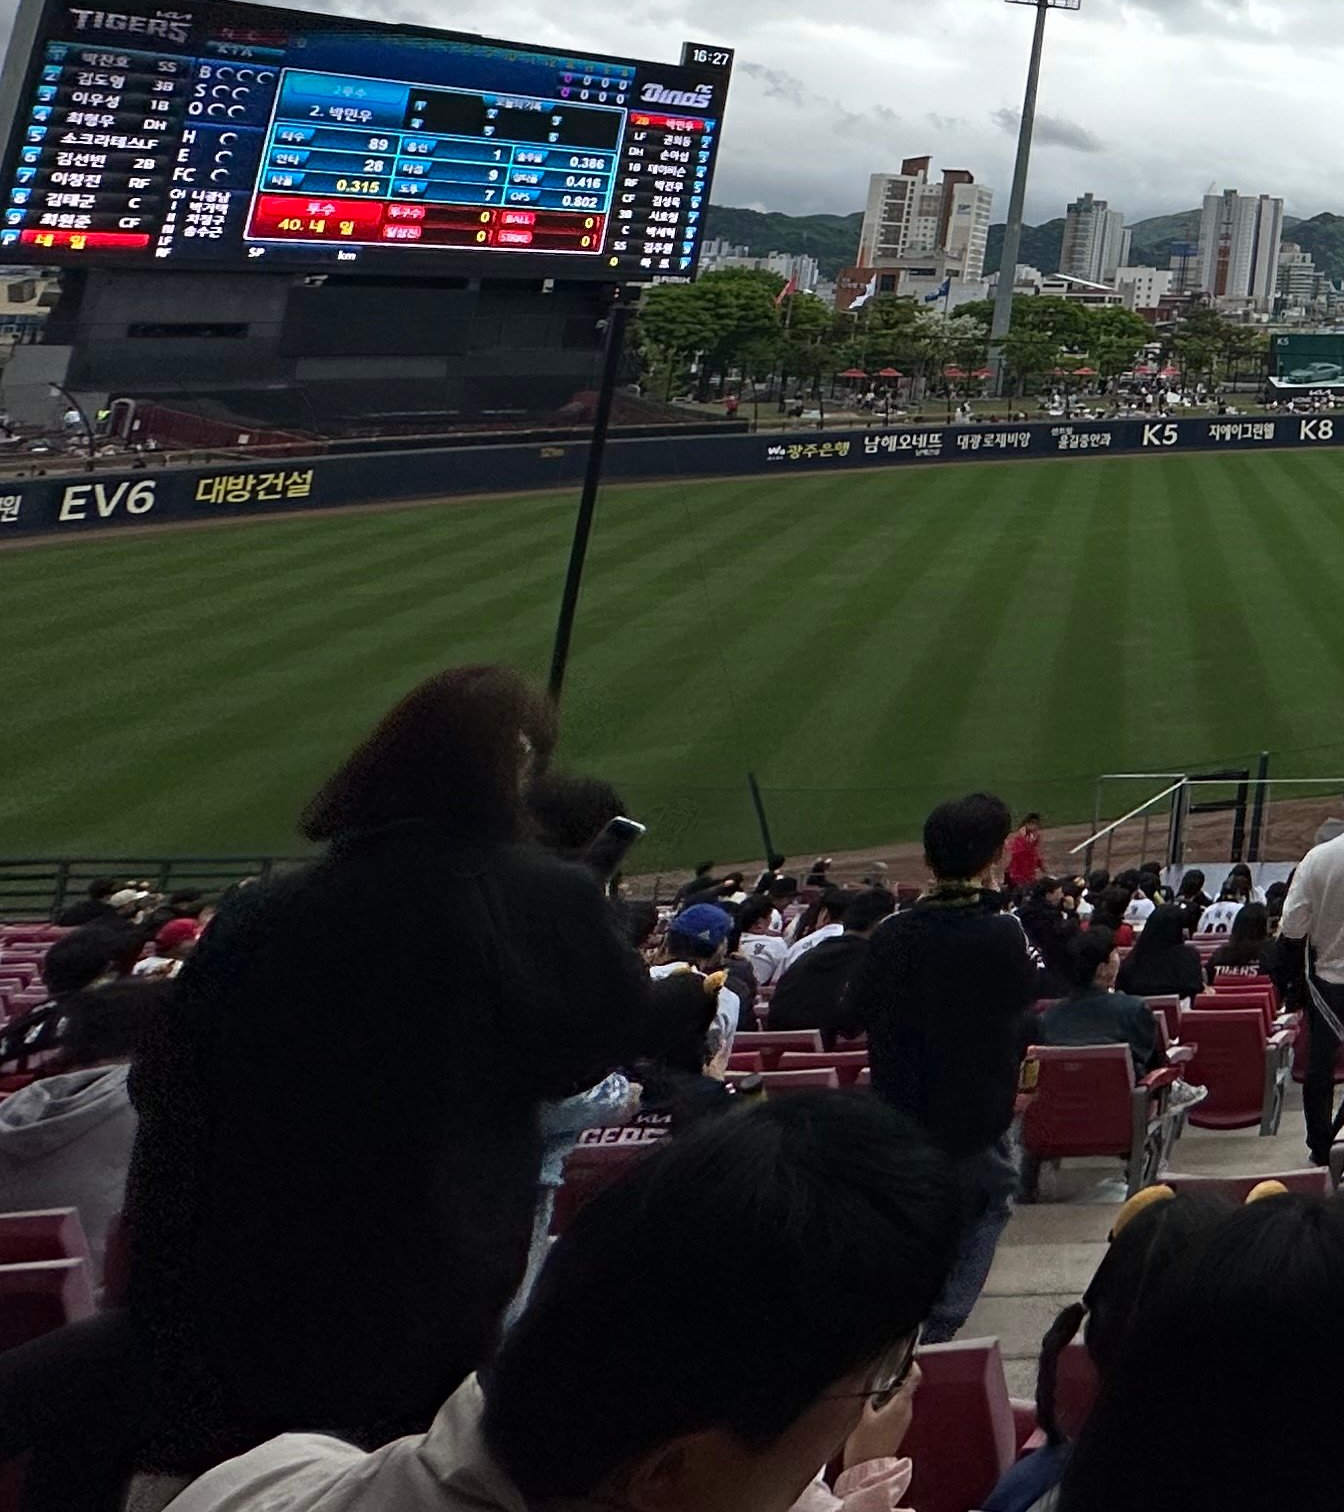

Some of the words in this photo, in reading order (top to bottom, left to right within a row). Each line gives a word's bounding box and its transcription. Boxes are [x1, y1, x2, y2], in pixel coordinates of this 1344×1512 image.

[68, 8, 192, 43] TIGERS
[693, 49, 730, 66] 16:27
[199, 66, 211, 78] B
[77, 72, 126, 88] 김도영
[152, 80, 174, 92] 3B
[194, 84, 207, 97] S
[72, 91, 121, 108] 이우성
[150, 100, 170, 111] 1B
[143, 119, 167, 131] DH
[182, 130, 196, 143] H
[368, 138, 388, 151] 89
[56, 152, 107, 168] 김선빈
[133, 158, 155, 169] 2B
[177, 149, 190, 162] E
[493, 149, 502, 161] 1
[173, 167, 196, 182] FC
[488, 170, 499, 181] 9
[128, 177, 151, 189] RF
[336, 179, 380, 194] 0.315
[45, 192, 96, 208] 김태군
[128, 198, 141, 208] C
[484, 189, 496, 201] 7
[510, 192, 530, 202] OPS
[119, 217, 141, 228] CF
[480, 211, 490, 223] 0
[585, 217, 594, 229] 0
[476, 231, 486, 242] 0
[621, 226, 630, 235] C
[581, 235, 591, 247] 0
[1143, 424, 1179, 446] K5
[1300, 419, 1333, 440] K8
[787, 441, 850, 460] 광주은행
[195, 470, 314, 503] 대방건설
[59, 480, 156, 521] EV6
[1214, 965, 1260, 977] TIGERS
[636, 1114, 672, 1123] KIA
